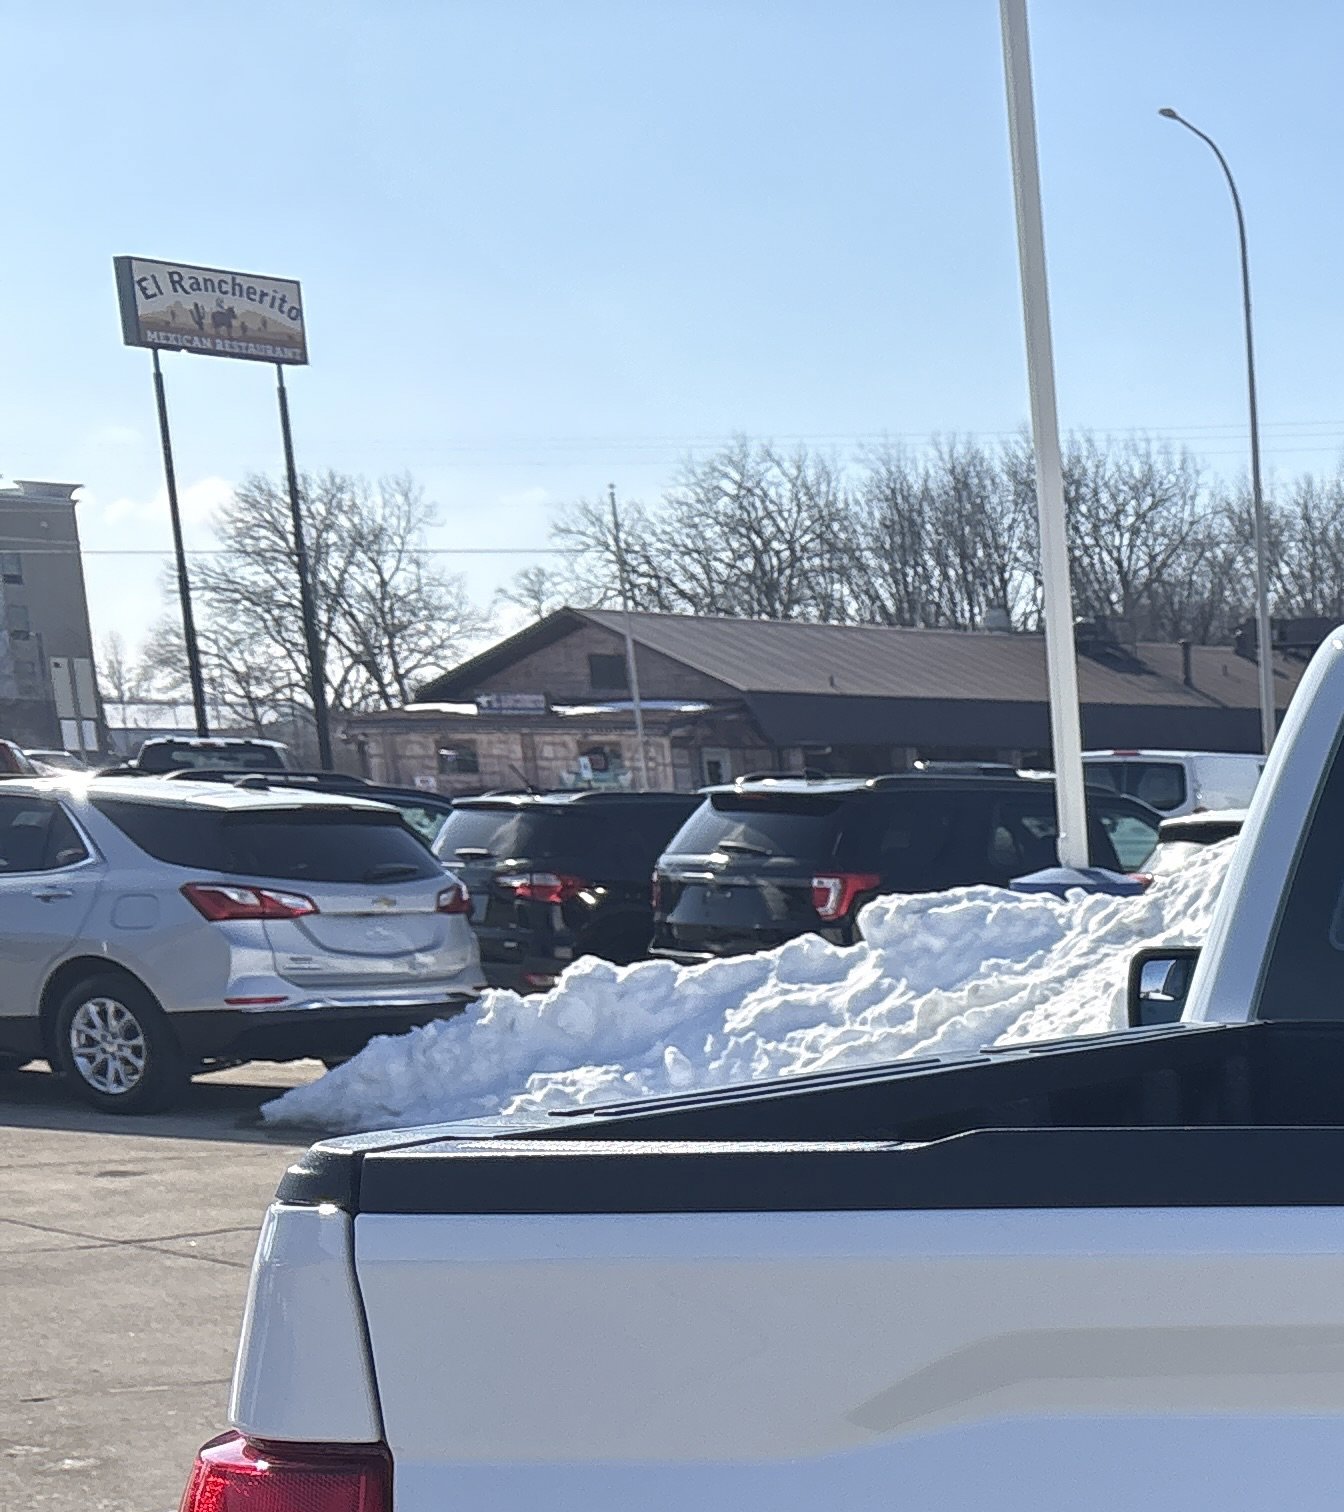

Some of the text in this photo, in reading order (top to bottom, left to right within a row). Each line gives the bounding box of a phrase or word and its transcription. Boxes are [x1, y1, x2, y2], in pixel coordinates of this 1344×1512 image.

[136, 270, 303, 321] El Rancherito
[146, 330, 213, 349] MEXICAN
